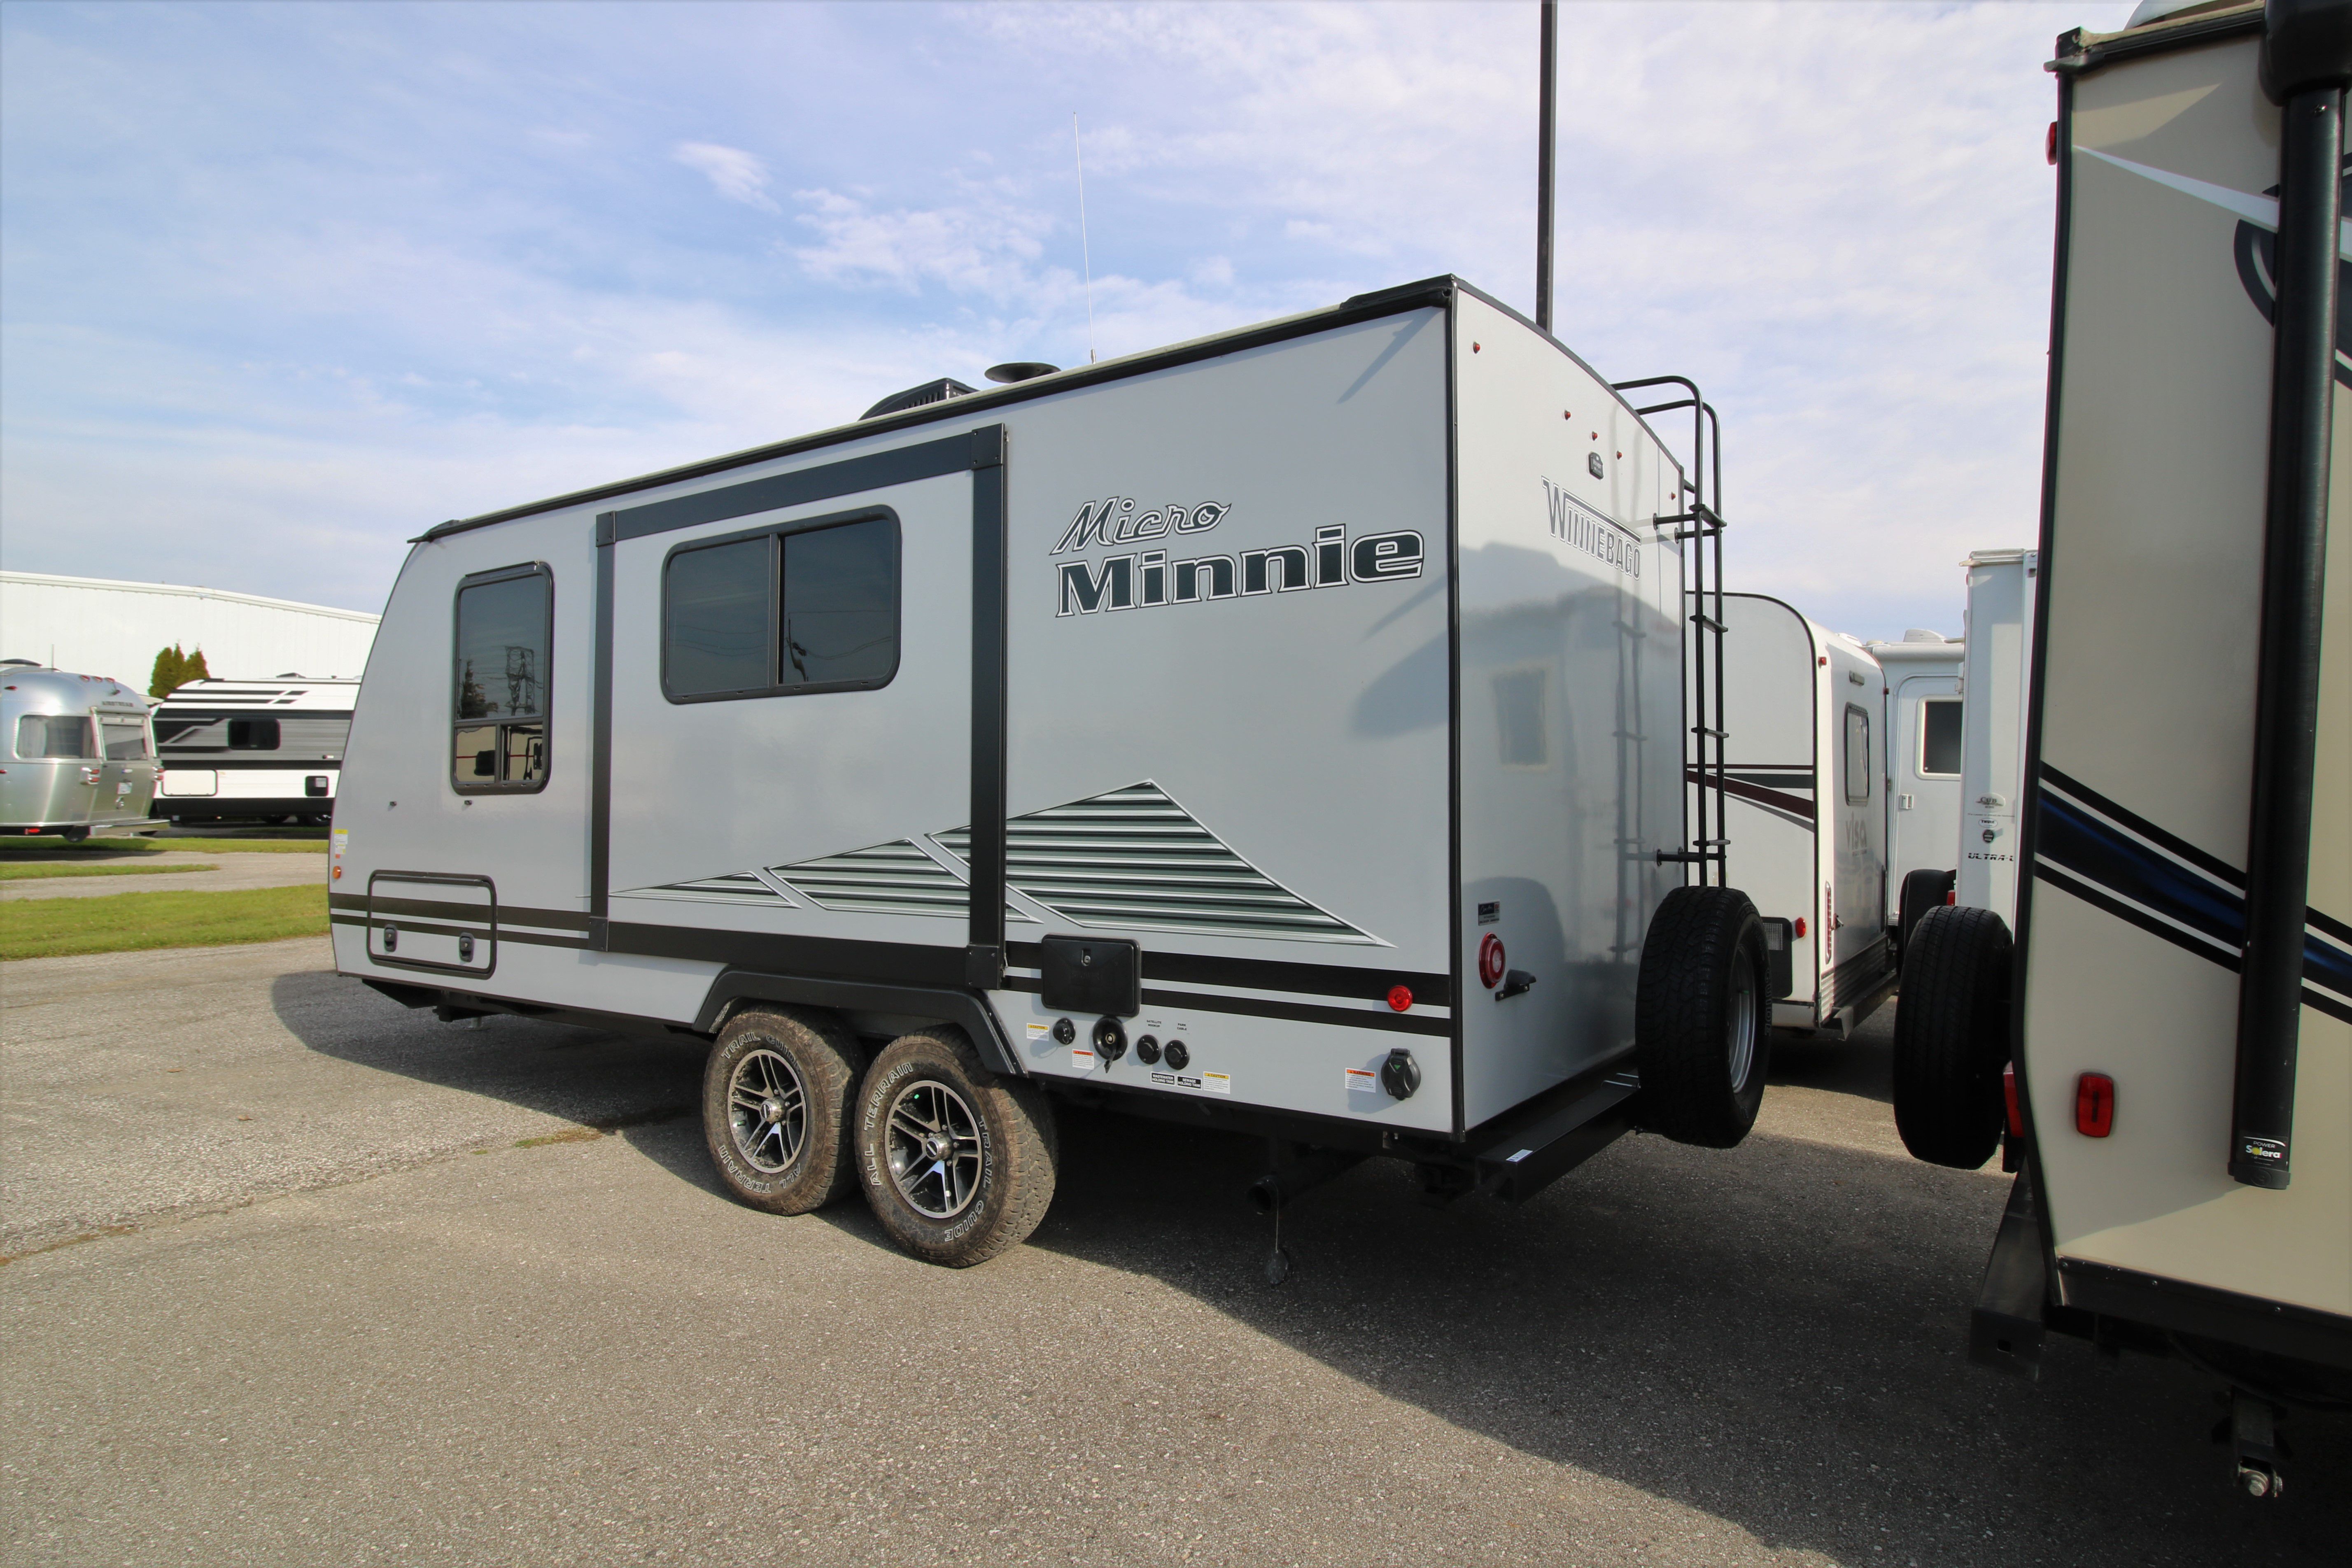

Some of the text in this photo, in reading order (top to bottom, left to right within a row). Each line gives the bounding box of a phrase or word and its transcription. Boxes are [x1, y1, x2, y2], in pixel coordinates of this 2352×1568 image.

[1049, 496, 1232, 555] Micro
[1541, 475, 1641, 580] WINNEBAGO
[1055, 523, 1424, 618] Minnie
[721, 1032, 761, 1059] TRAIL
[864, 1062, 913, 1186] ALL TERRAIN
[2246, 1145, 2282, 1158] Solera
[718, 1145, 801, 1194] ALL TERRAIN
[944, 1115, 992, 1242] TRAIL GUIDE
